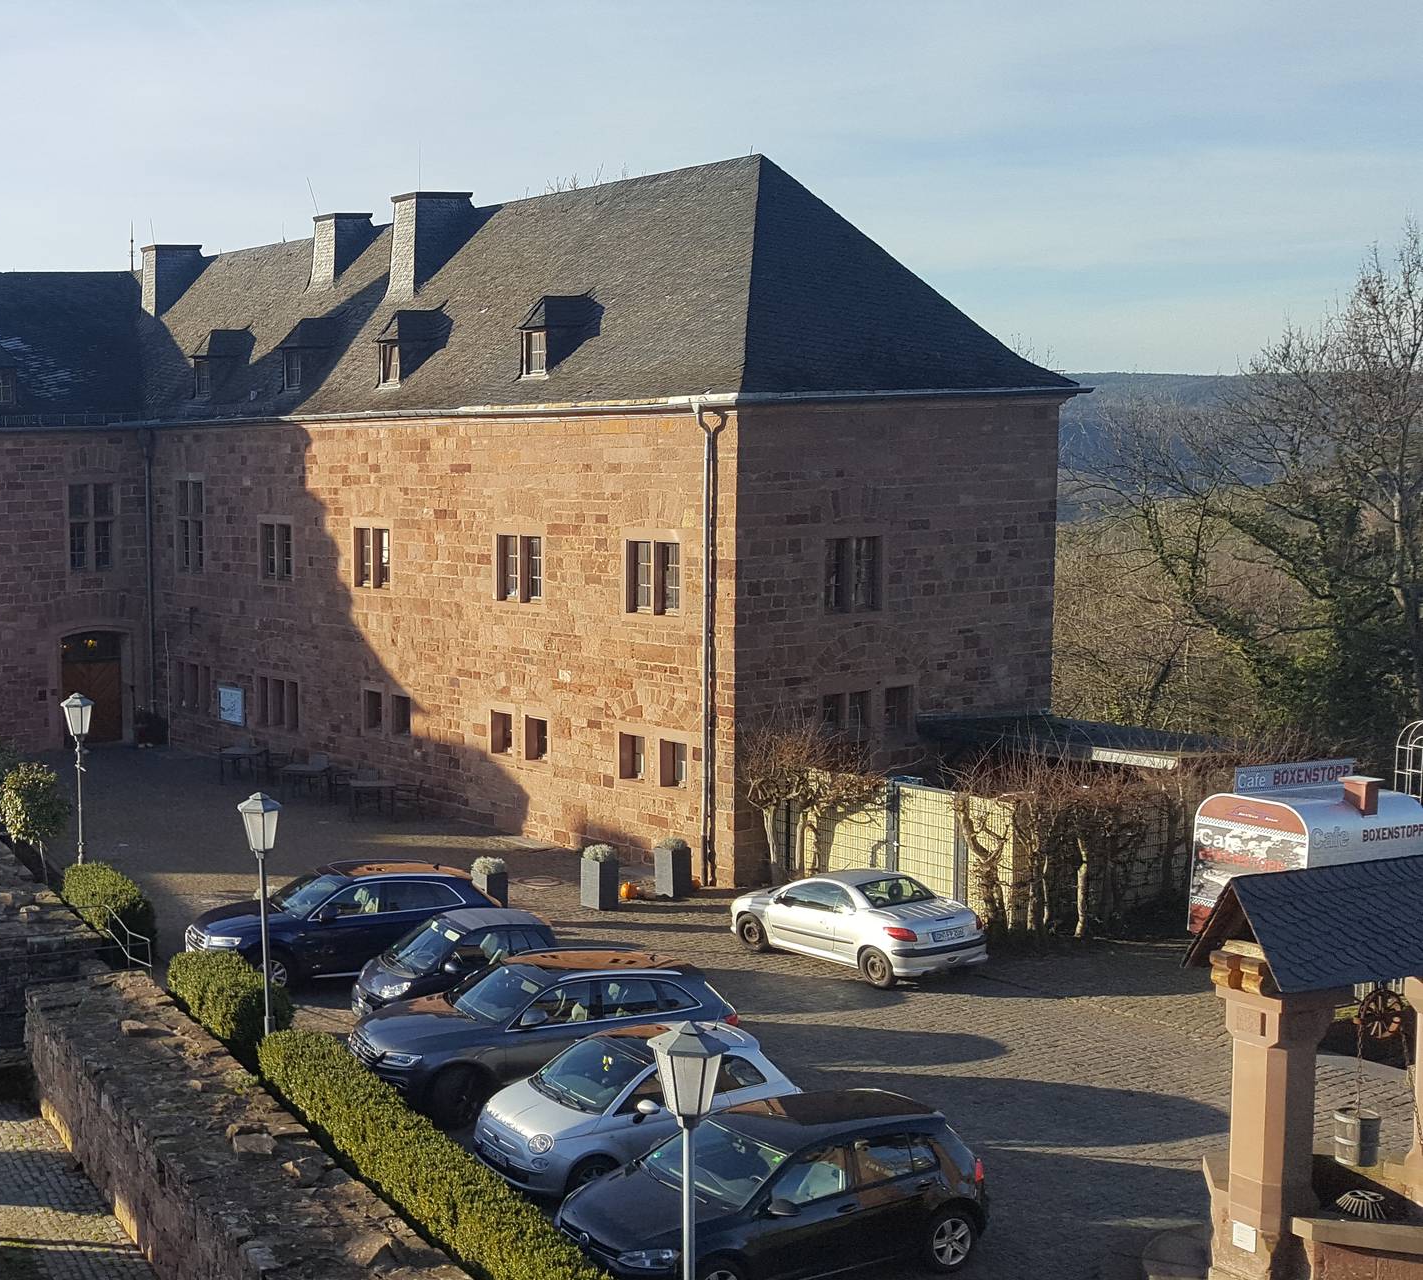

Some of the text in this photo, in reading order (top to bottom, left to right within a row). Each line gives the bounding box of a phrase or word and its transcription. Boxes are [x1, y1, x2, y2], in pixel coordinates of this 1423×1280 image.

[1238, 765, 1350, 789] Cafe BOXENSTOPP
[1312, 826, 1350, 849] Cafe
